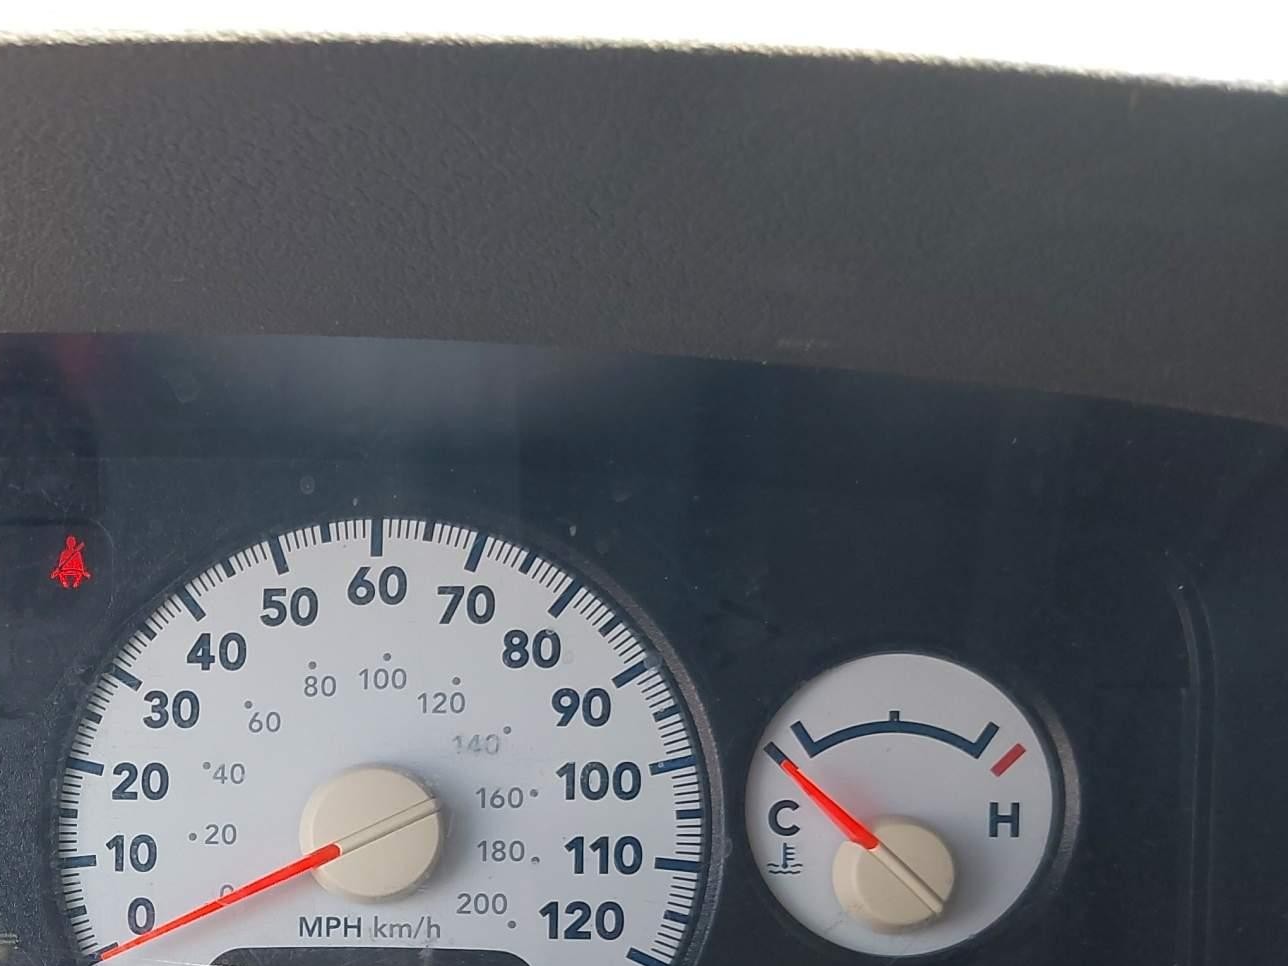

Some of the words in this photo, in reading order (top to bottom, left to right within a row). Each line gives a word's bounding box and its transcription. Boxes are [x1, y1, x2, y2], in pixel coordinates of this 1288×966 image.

[347, 566, 407, 605] 60
[261, 588, 318, 627] 50
[437, 586, 495, 624] 70
[187, 633, 247, 671] 40
[503, 630, 561, 668] 80
[304, 676, 336, 697] 80
[359, 669, 407, 689] 100
[143, 690, 199, 729] 30
[418, 693, 465, 714] 120
[551, 688, 610, 726] 90
[249, 711, 280, 733] 60
[453, 734, 500, 754] 140
[111, 763, 168, 800] 20
[212, 763, 245, 785] 40
[555, 762, 641, 800] 100
[476, 787, 524, 808] 160
[205, 824, 236, 845] 20
[768, 799, 800, 836] C
[989, 802, 1020, 837] H
[106, 834, 157, 872] 10
[478, 841, 525, 862] 180
[565, 836, 642, 874] 110
[128, 898, 156, 934] 0
[457, 894, 507, 915] 200
[539, 901, 625, 939] 120
[298, 916, 362, 938] MPH
[372, 915, 440, 939] km/h
